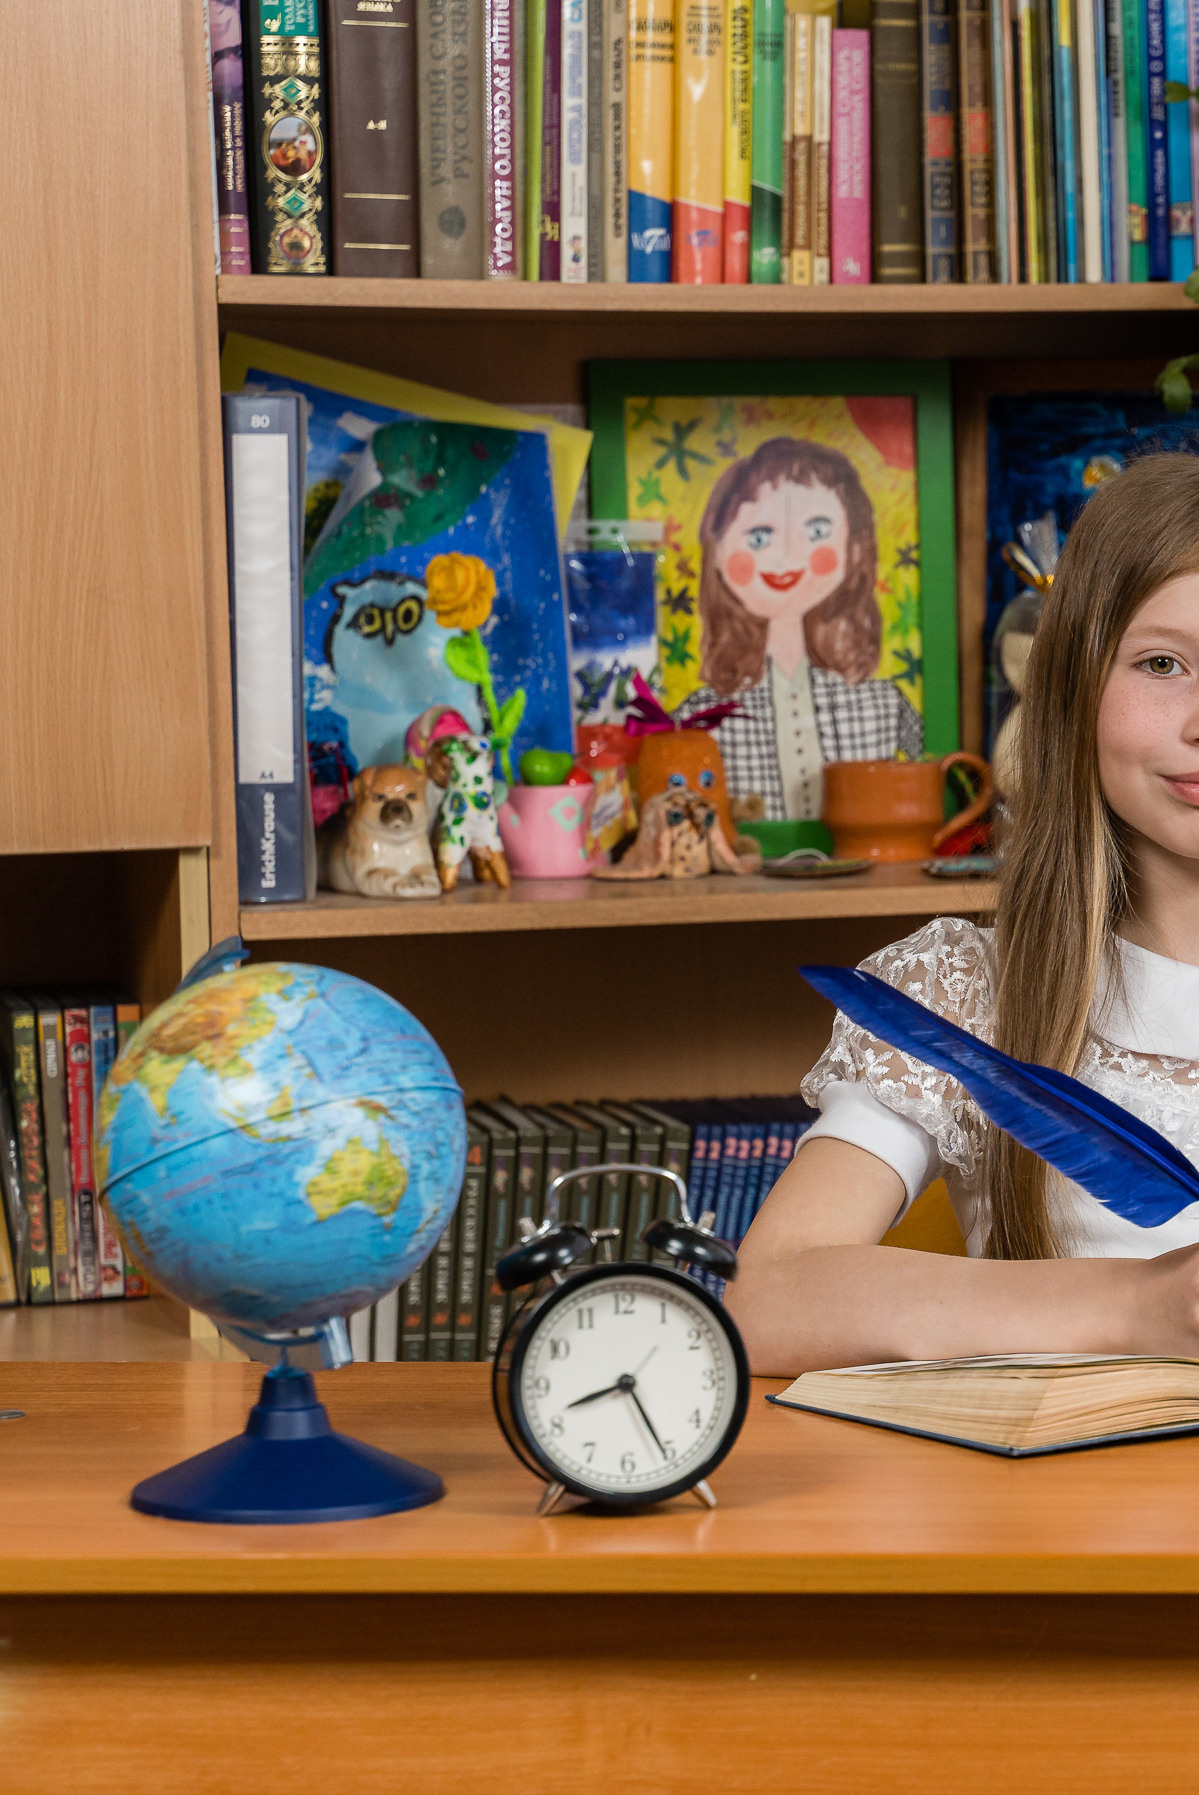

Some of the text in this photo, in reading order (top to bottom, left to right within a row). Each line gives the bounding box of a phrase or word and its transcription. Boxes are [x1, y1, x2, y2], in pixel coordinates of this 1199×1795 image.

[1149, 59, 1164, 74] О
[451, 55, 473, 180] РУССКОГО
[493, 64, 512, 175] РУССКОГО
[493, 178, 513, 267] НАРОДА
[251, 414, 271, 429] 80
[260, 791, 276, 889] ErichKrause
[461, 1177, 480, 1304] РУССКИЙ ЯЗЫК
[613, 1293, 636, 1315] 12
[659, 1302, 667, 1324] 1
[577, 1307, 594, 1330] 11
[550, 1337, 570, 1360] 10
[687, 1328, 701, 1350] 2
[535, 1377, 550, 1398] 9
[702, 1369, 716, 1391] 3
[550, 1415, 565, 1437] 8
[688, 1408, 702, 1429] 4
[583, 1441, 597, 1463] 7
[665, 1440, 676, 1461] 5
[620, 1452, 636, 1473] 6
